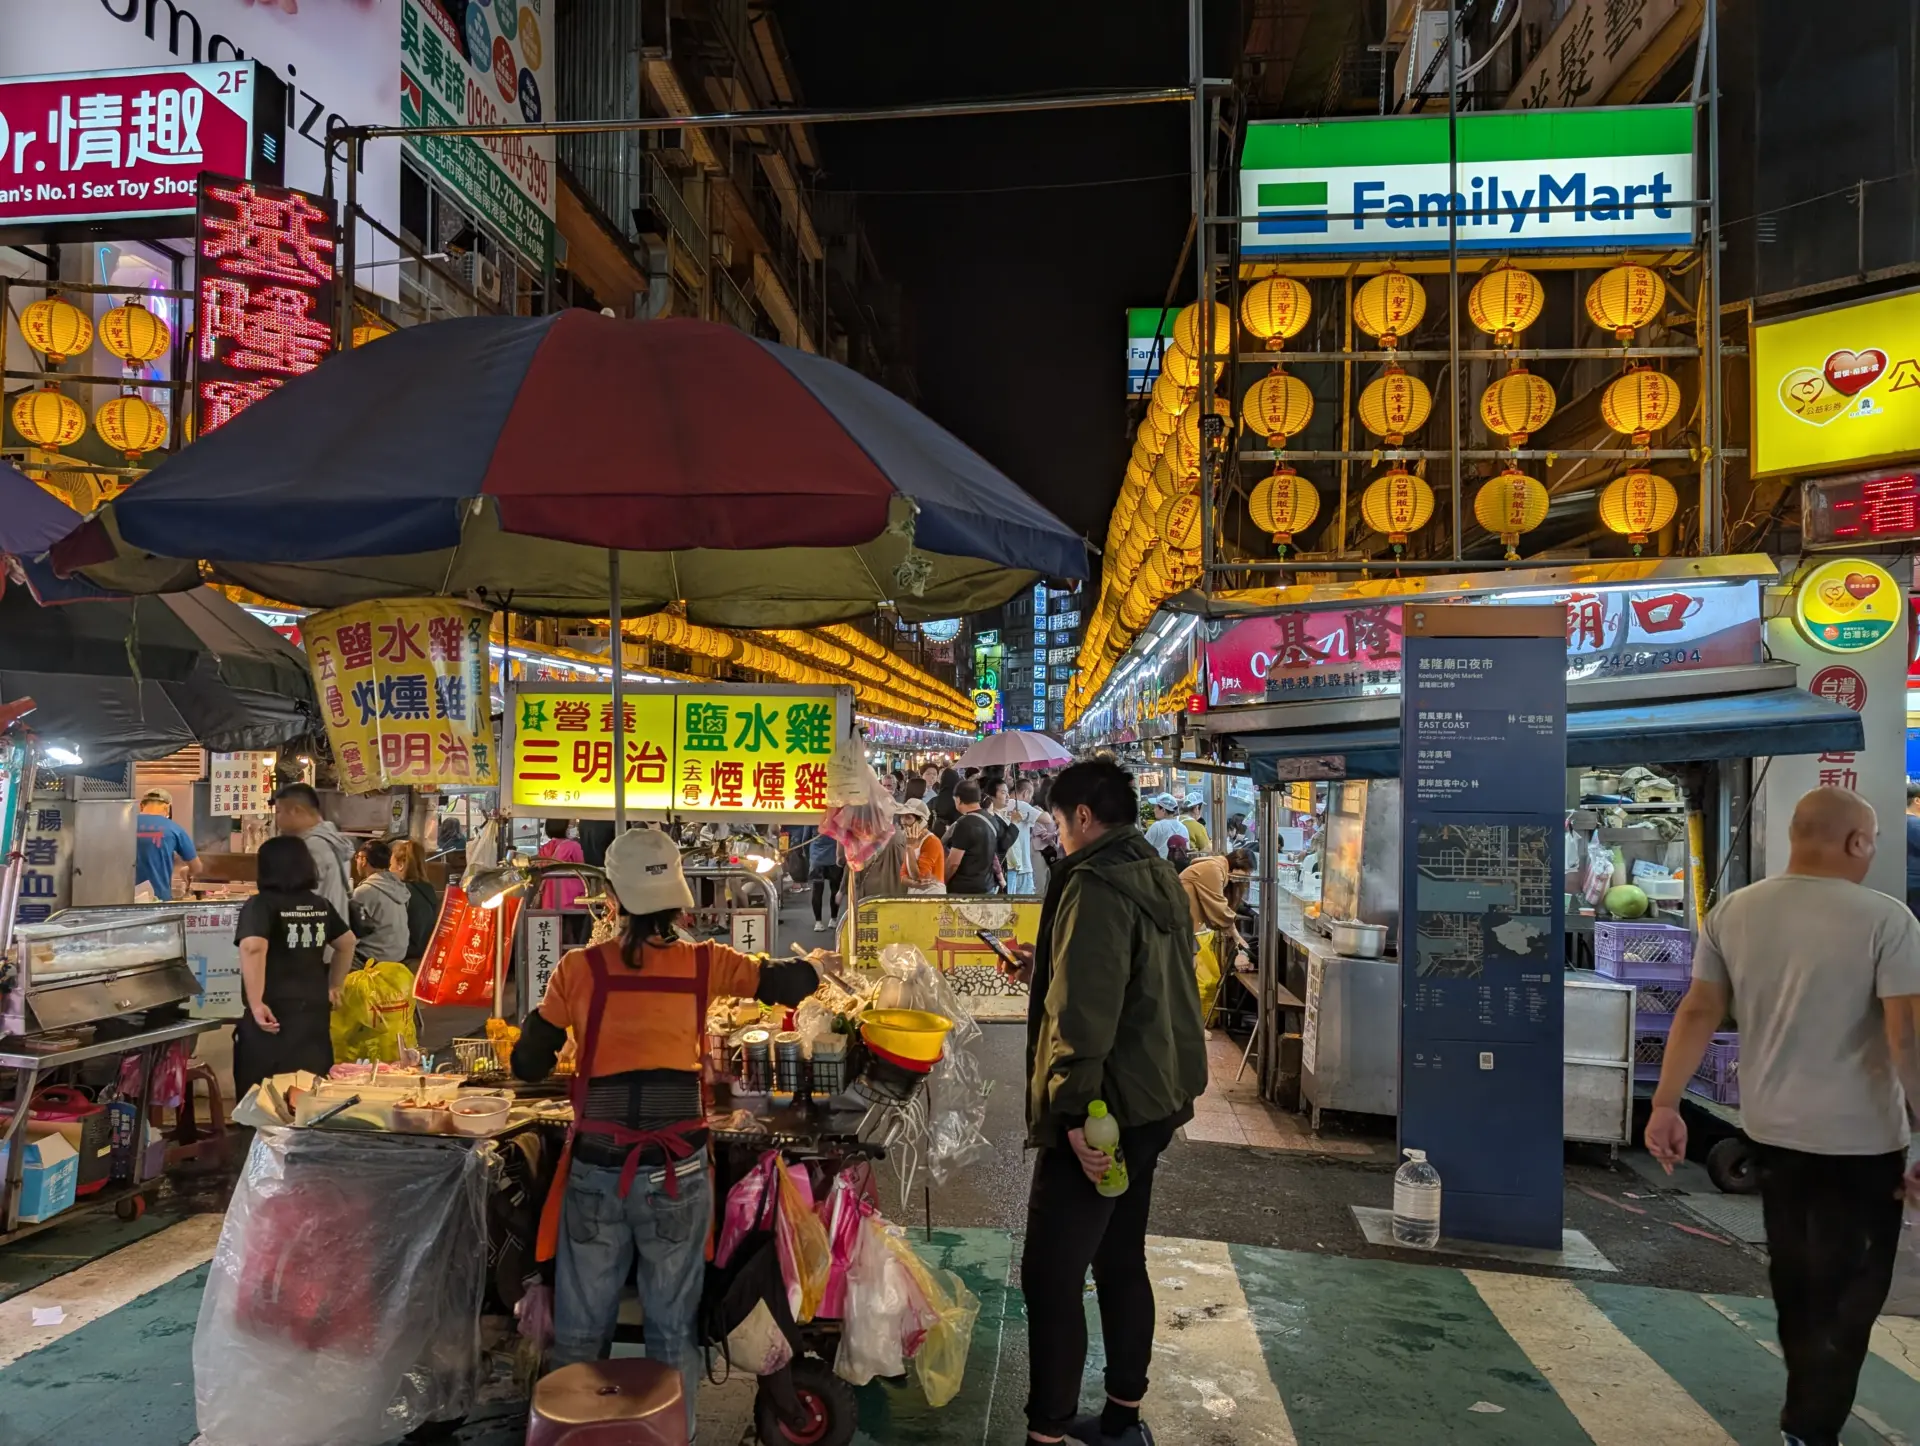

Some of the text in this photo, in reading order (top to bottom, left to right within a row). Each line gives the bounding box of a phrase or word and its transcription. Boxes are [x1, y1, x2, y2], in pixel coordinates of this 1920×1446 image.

[217, 70, 249, 94] 2F
[0, 88, 204, 174] r.情趣
[467, 78, 548, 206] 0936809-399
[37, 183, 77, 200] No.1
[82, 182, 115, 198] Sex
[117, 179, 150, 199] Toy
[154, 176, 198, 196] Shop
[1353, 171, 1673, 233] FamilyMart
[490, 171, 545, 241] 02-2782-1234
[1889, 358, 1920, 393] 公
[1169, 496, 1194, 541] 歡迎光臨
[335, 616, 465, 671] 鹽水雞
[1271, 603, 1404, 671] 基隆
[1418, 658, 1494, 671] 基隆廟口夜市
[1599, 648, 1701, 669] 24267304
[1418, 673, 1443, 681] Keelung
[1444, 673, 1461, 681] Night
[1820, 676, 1857, 694] 台灣
[552, 700, 637, 734] 營養
[683, 702, 833, 756] 鹽水雞
[1418, 712, 1453, 721] 微風東岸
[1518, 714, 1554, 724] 仁愛市場
[369, 732, 471, 777] 明治
[518, 739, 668, 784] 三明治
[1418, 750, 1452, 759] 海洋廣場
[524, 788, 581, 803] 一條 50
[682, 757, 703, 808] (去骨)
[709, 760, 830, 811] 煙燻雞
[1417, 779, 1469, 788] 東岸旅客中心
[741, 919, 758, 950] 下午
